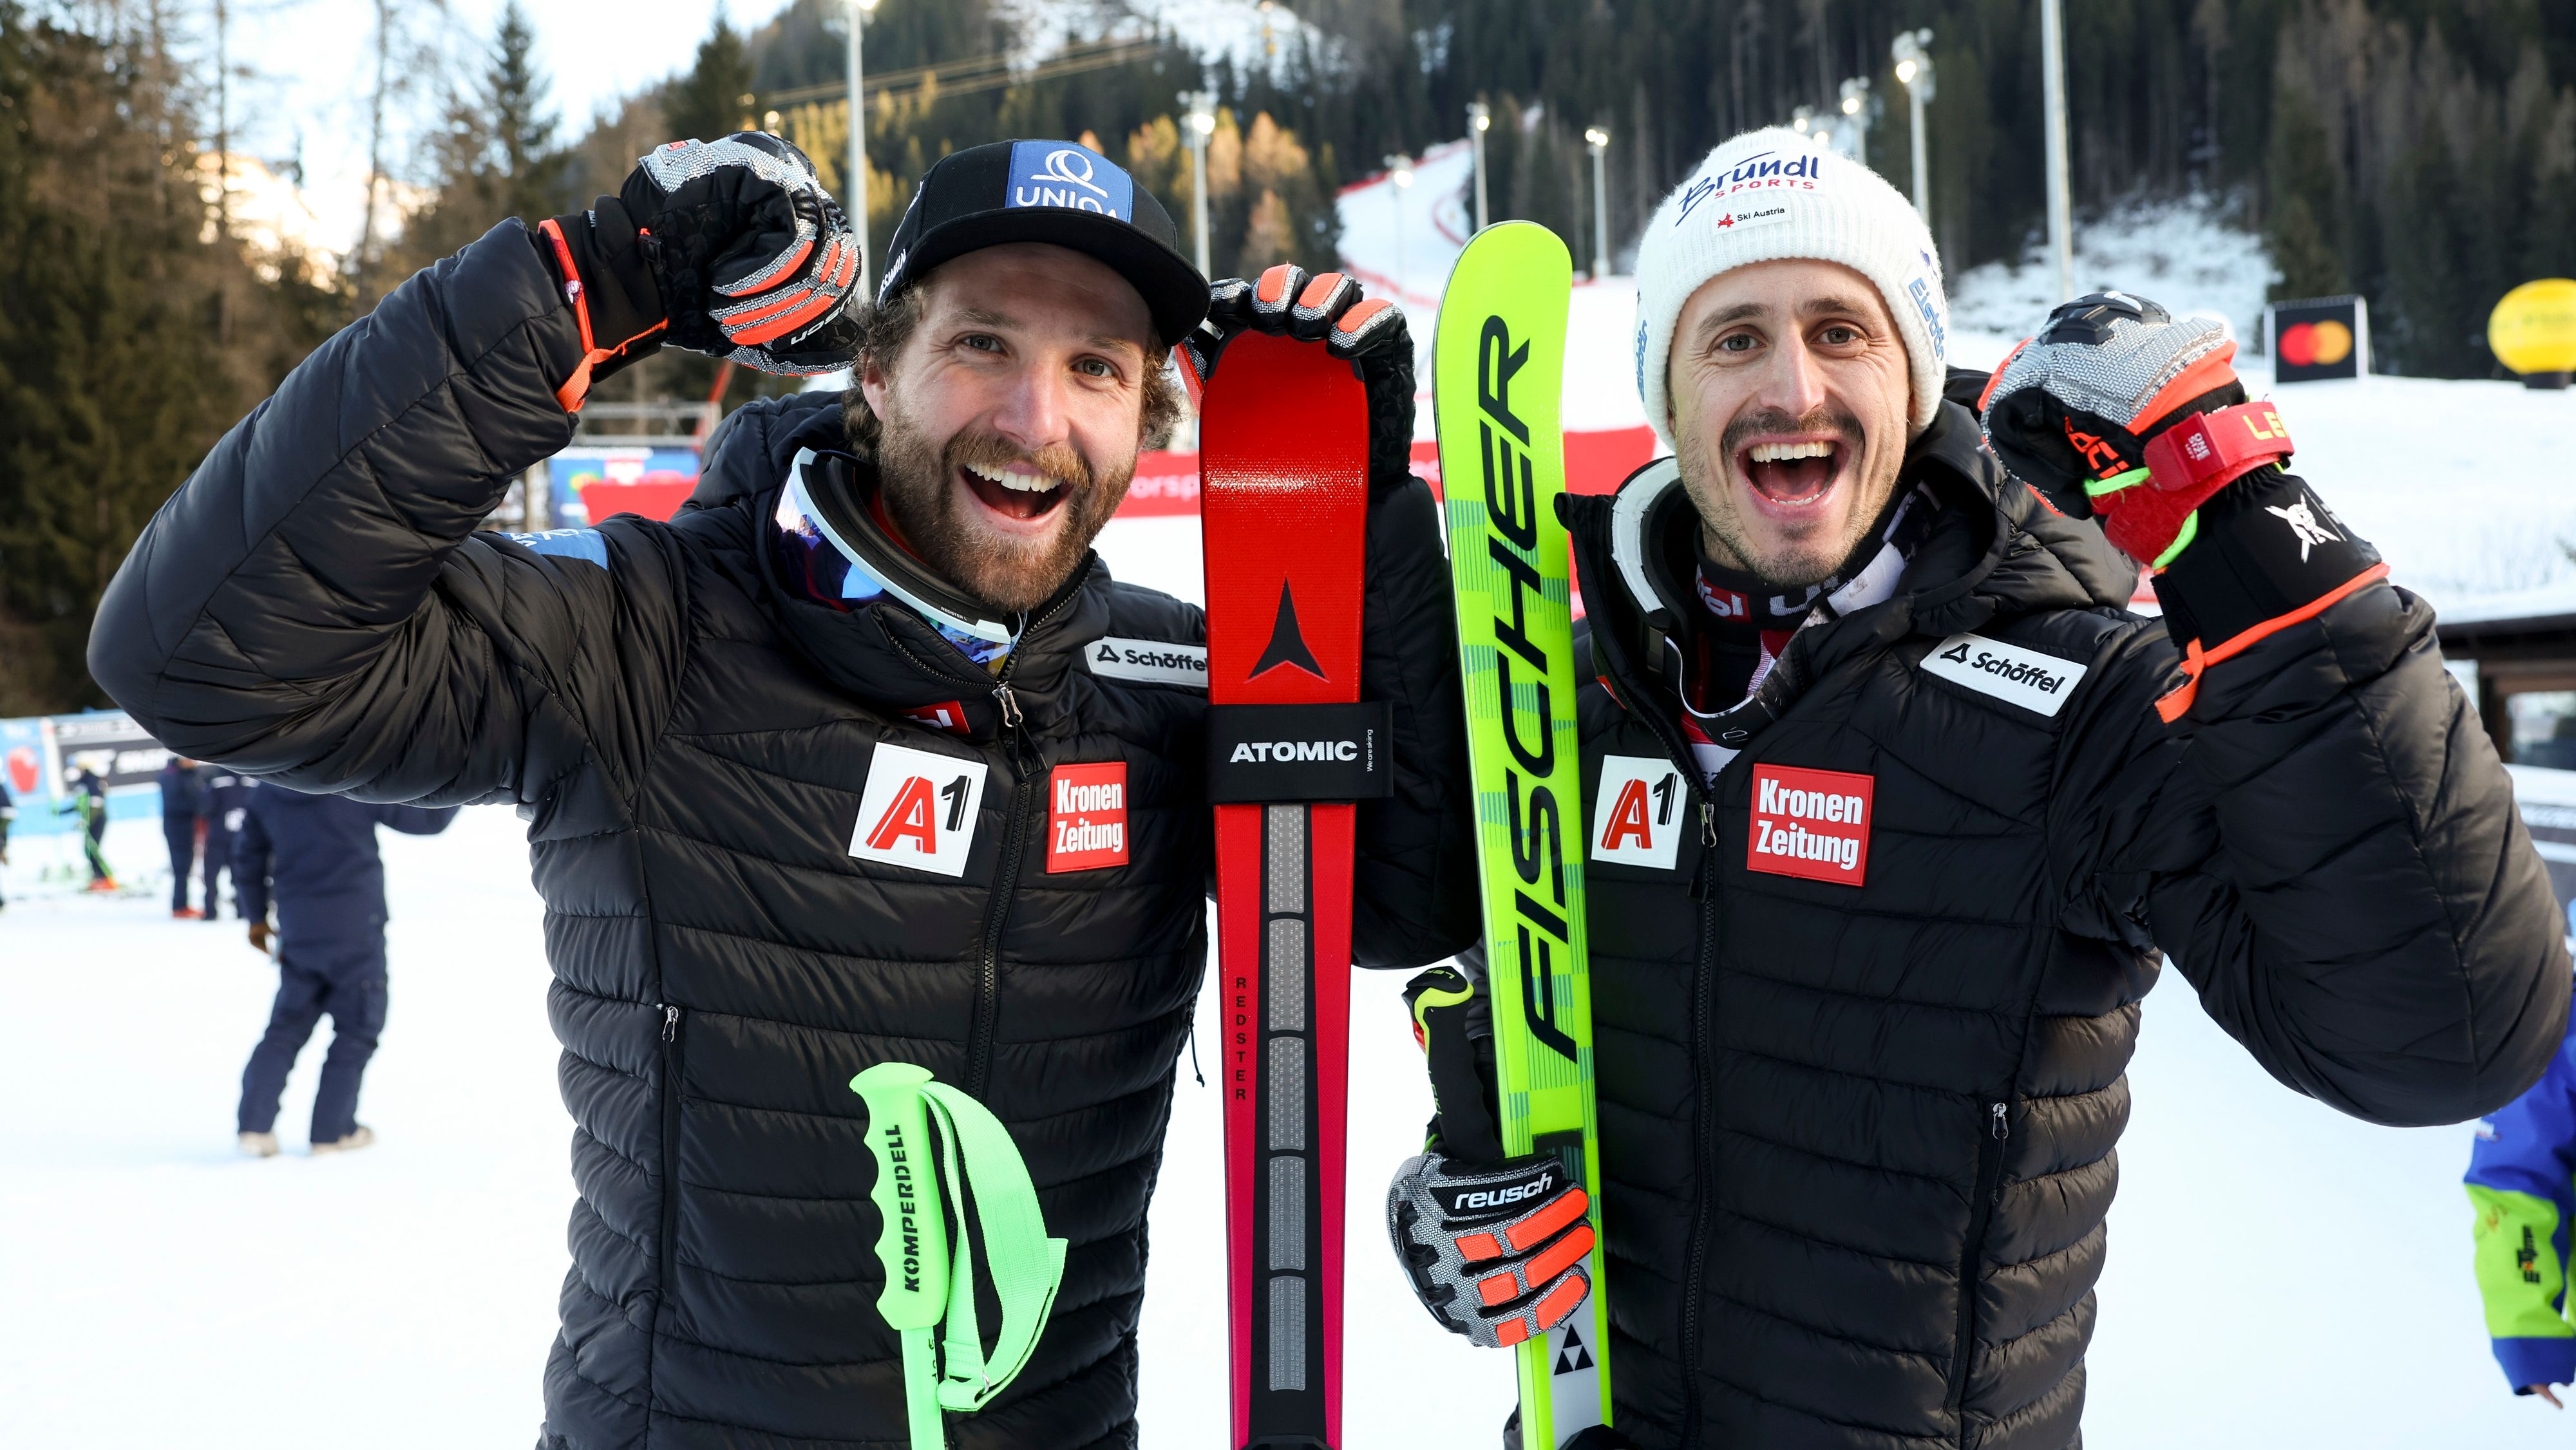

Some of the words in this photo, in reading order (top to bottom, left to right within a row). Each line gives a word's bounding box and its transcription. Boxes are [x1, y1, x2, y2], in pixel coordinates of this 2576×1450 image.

[1714, 178, 1814, 199] SPORTS
[1737, 213, 1751, 221] Ski
[1754, 207, 1785, 218] Austria
[1478, 315, 1578, 1064] FISCHER
[1971, 652, 2066, 694] Schöffel
[1229, 740, 1358, 763] ATOMIC
[1367, 760, 1373, 772] We
[865, 775, 972, 854] A1
[1056, 778, 1122, 814] Kronen
[1600, 772, 1678, 850] A1
[1758, 777, 1864, 825] Kronen
[1055, 817, 1123, 854] Zeitung
[1756, 820, 1860, 871] Zeitung
[1235, 976, 1247, 1100] REDSTER
[885, 1124, 920, 1293] KOMPERDELL
[1455, 1172, 1553, 1209] reusch
